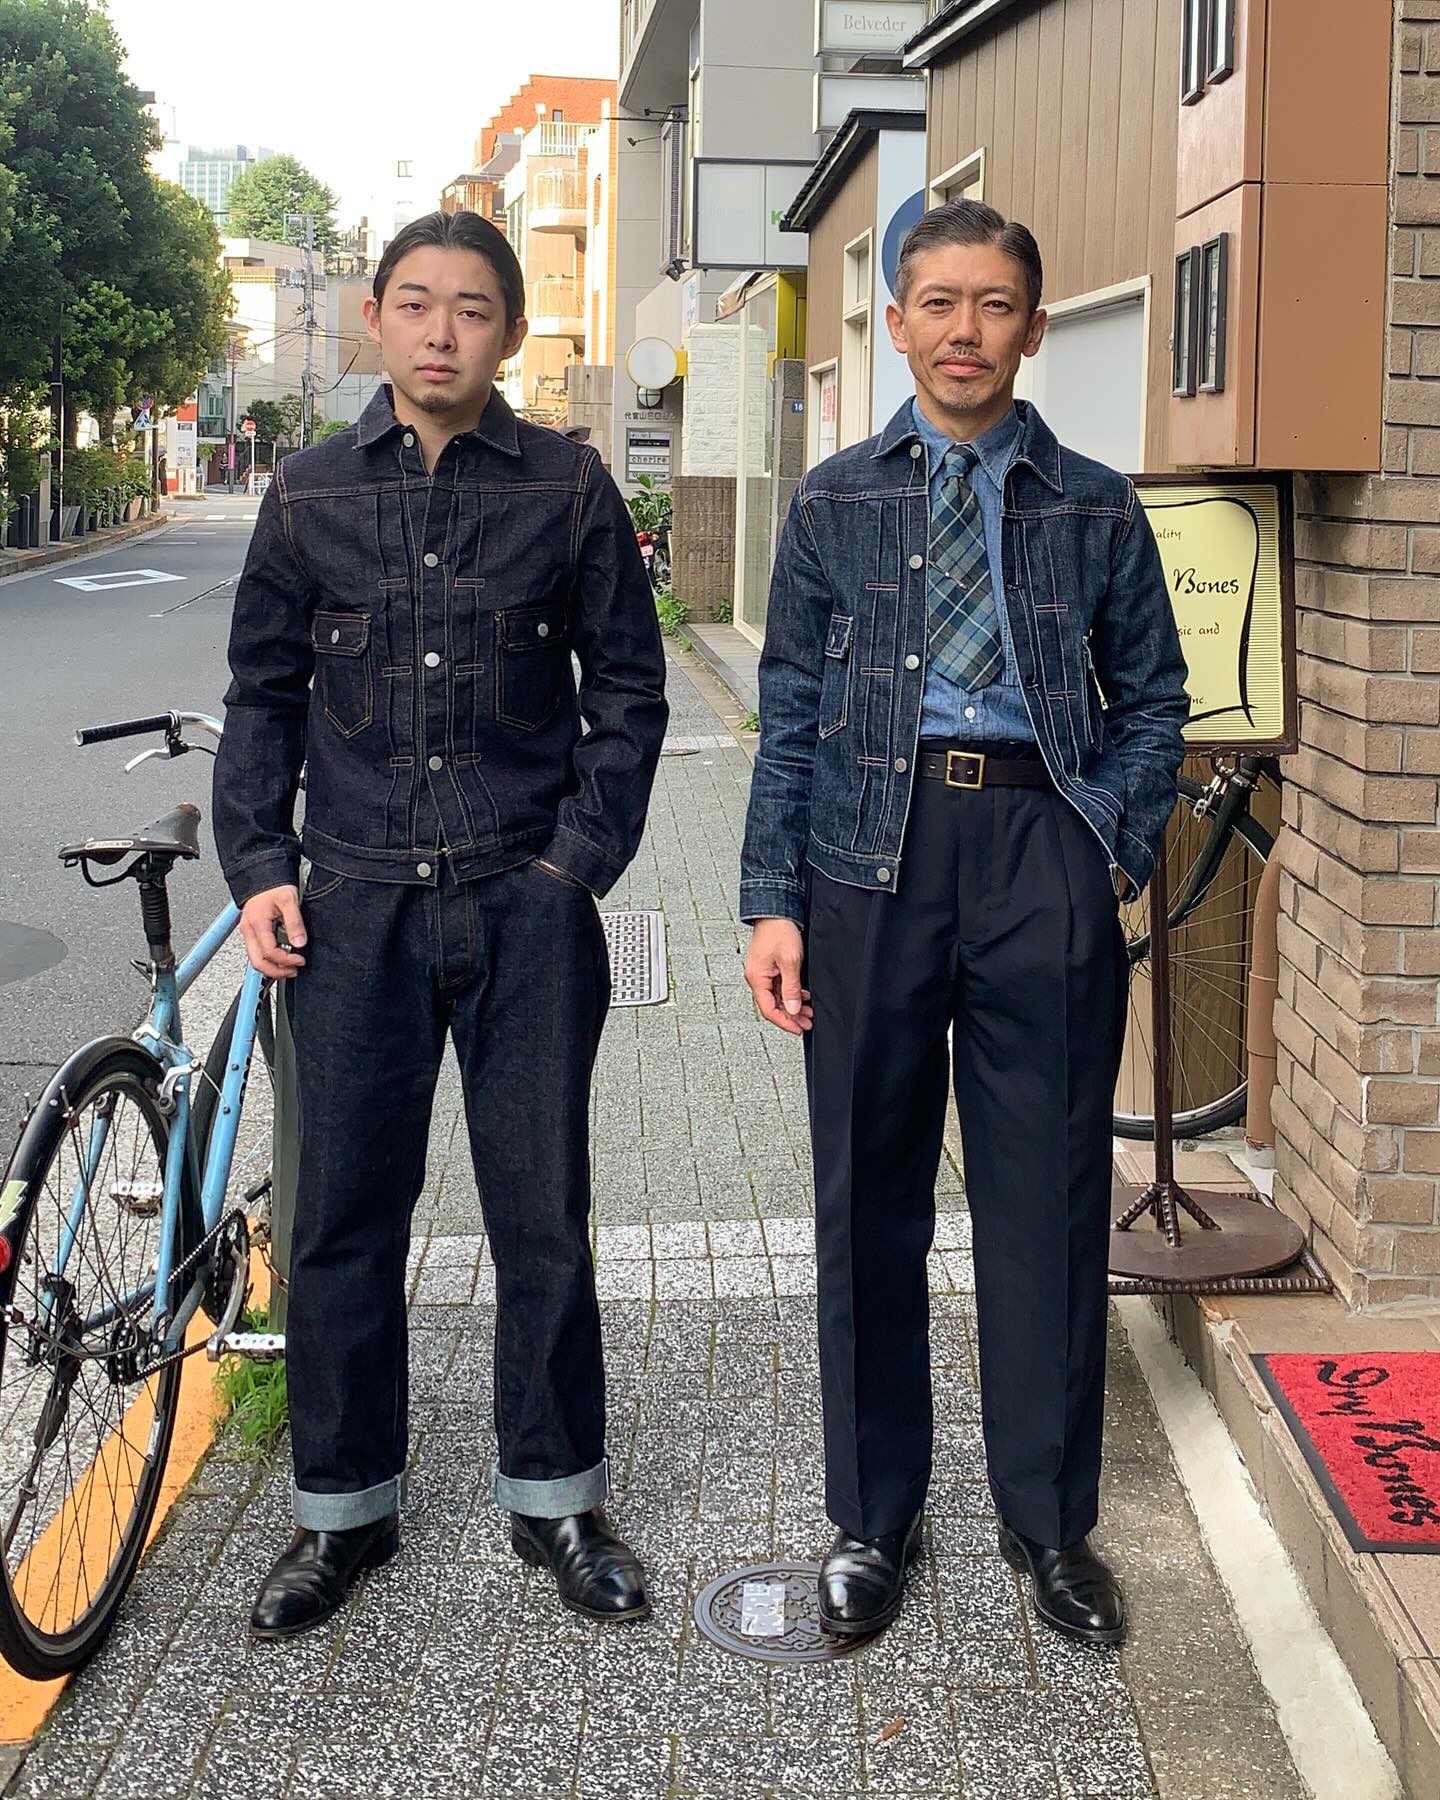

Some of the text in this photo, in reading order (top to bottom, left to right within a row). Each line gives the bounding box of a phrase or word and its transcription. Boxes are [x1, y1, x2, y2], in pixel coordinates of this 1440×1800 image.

[1155, 528, 1181, 541] ality
[1173, 567, 1239, 594] Bones
[1177, 621, 1220, 636] sic and
